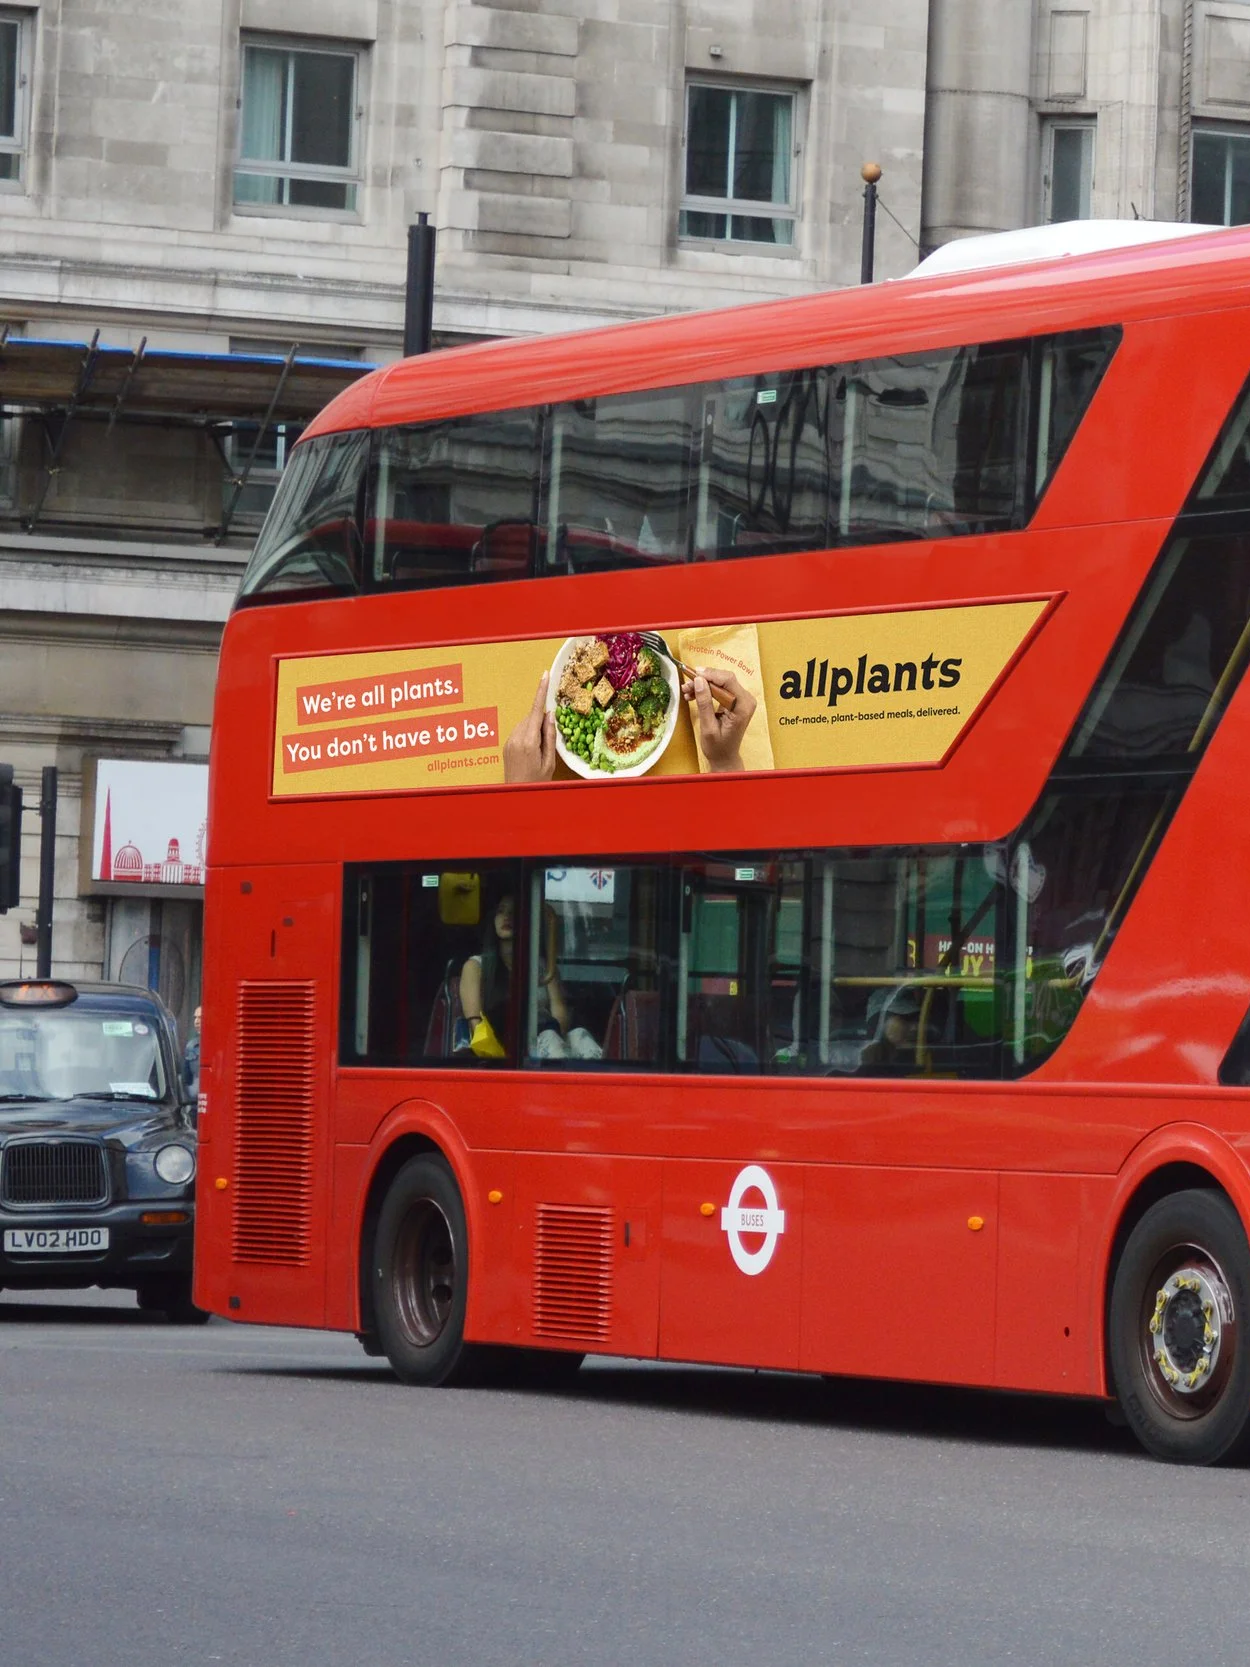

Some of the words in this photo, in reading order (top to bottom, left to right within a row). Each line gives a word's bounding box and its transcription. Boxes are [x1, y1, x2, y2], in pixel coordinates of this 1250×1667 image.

[688, 644, 715, 655] Protein
[716, 649, 738, 664] Power
[737, 660, 755, 676] Bowl
[778, 652, 963, 707] allplants
[303, 691, 356, 715] We’re
[361, 684, 385, 706] all
[391, 678, 459, 708] plants.
[778, 714, 830, 726] Chef-made,
[831, 710, 885, 725] plant-based
[886, 709, 916, 720] meals,
[916, 705, 961, 717] delivered.
[286, 743, 322, 763] You
[326, 733, 378, 757] don’t
[382, 730, 431, 750] have
[436, 725, 458, 743] to
[463, 719, 495, 740] be.
[427, 754, 500, 773] allplants.com
[741, 1214, 764, 1227] BUSES
